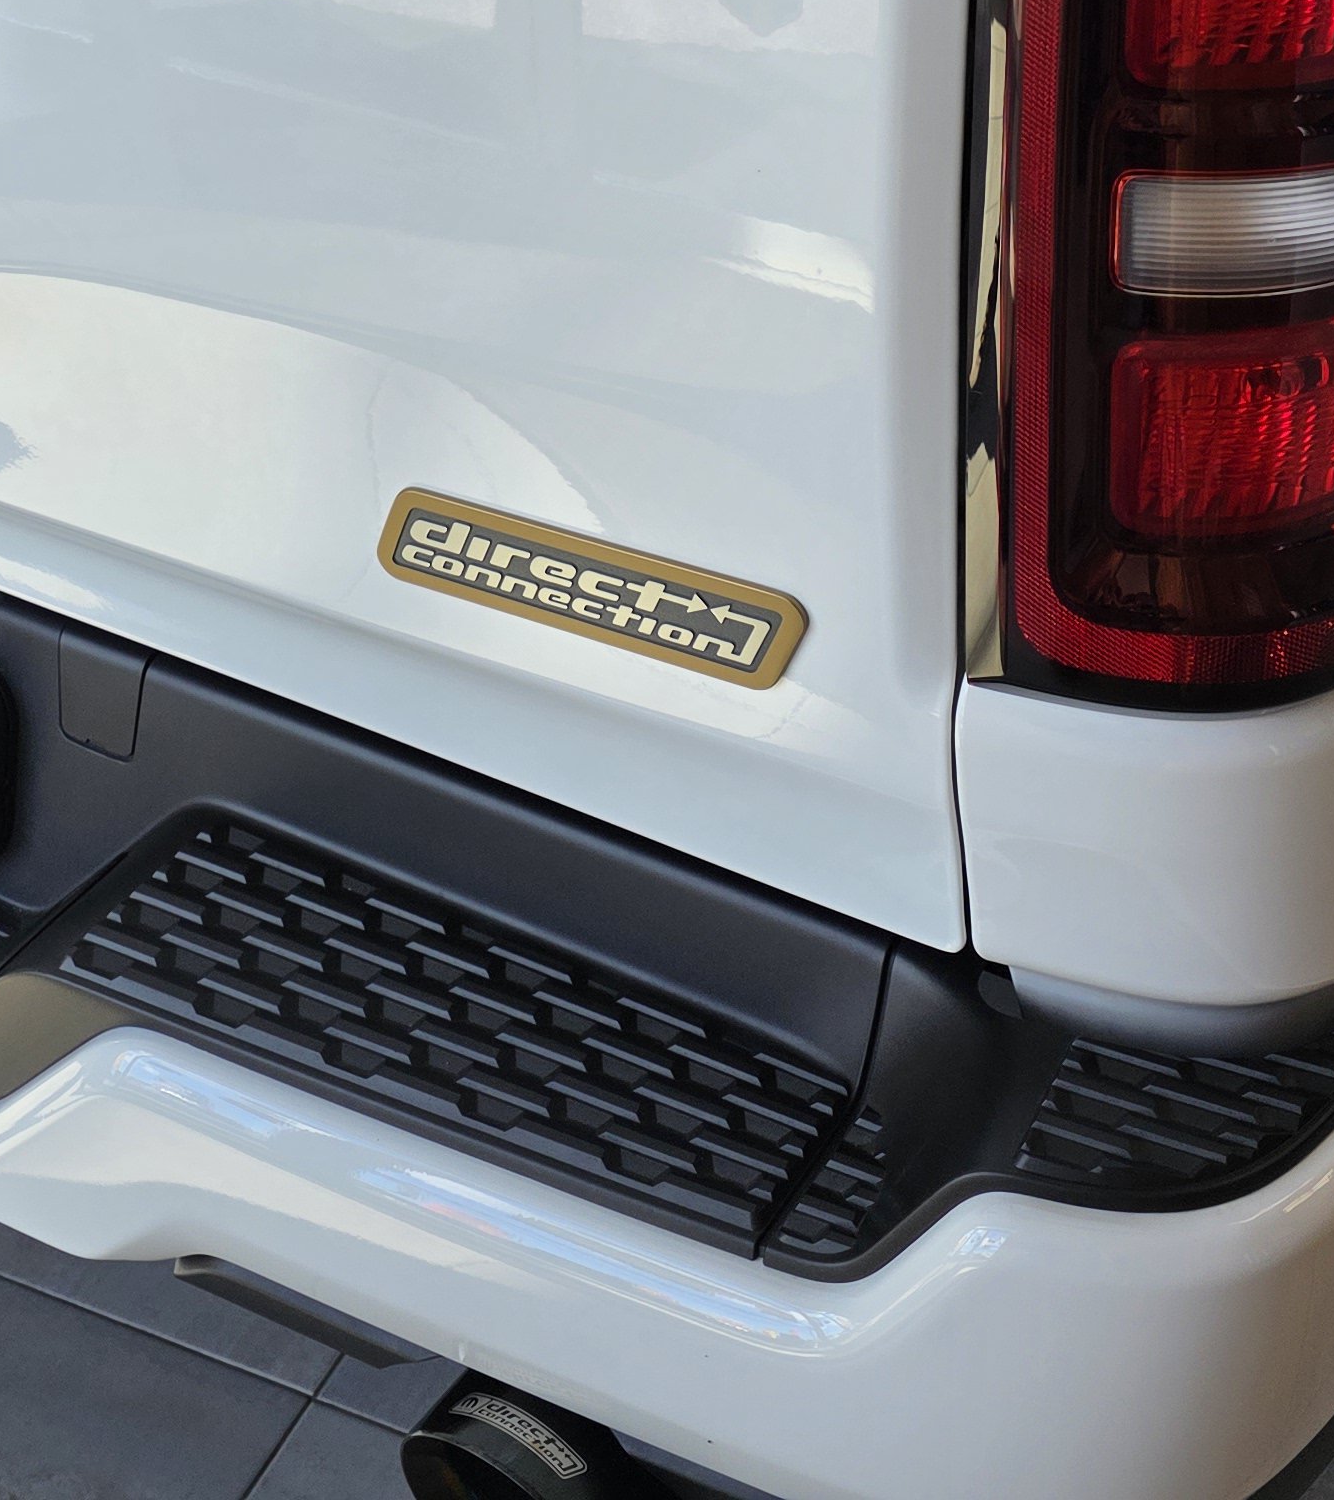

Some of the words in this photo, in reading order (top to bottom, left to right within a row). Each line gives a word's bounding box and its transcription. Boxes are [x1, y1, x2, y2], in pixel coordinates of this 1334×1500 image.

[401, 543, 771, 666] connection
[409, 518, 671, 613] direct
[478, 1408, 578, 1472] connection
[486, 1403, 558, 1446] direct
